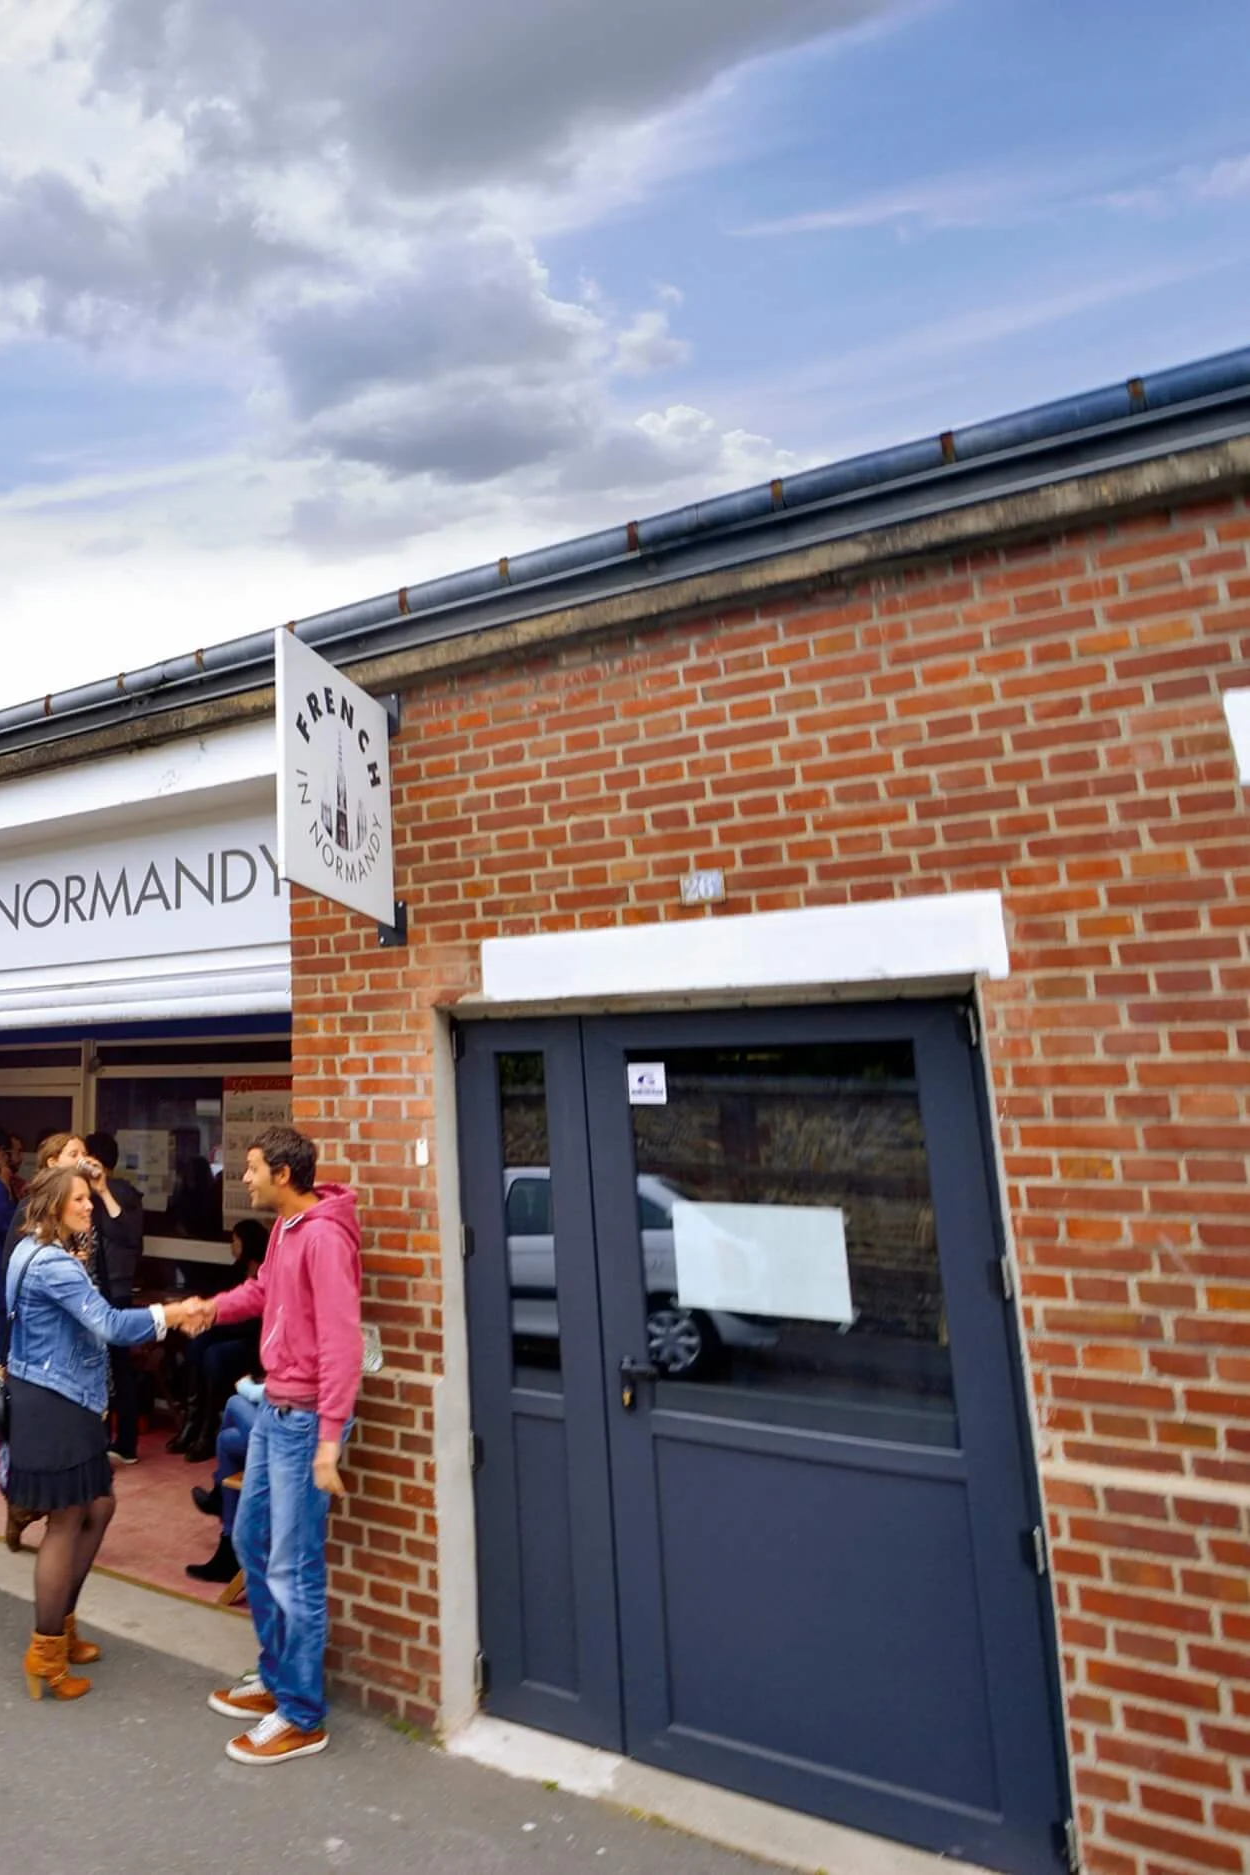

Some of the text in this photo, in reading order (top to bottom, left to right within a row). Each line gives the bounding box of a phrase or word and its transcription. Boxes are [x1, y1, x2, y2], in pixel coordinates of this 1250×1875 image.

[295, 687, 382, 787] FRENCH
[296, 768, 383, 884] IN NORMANDY
